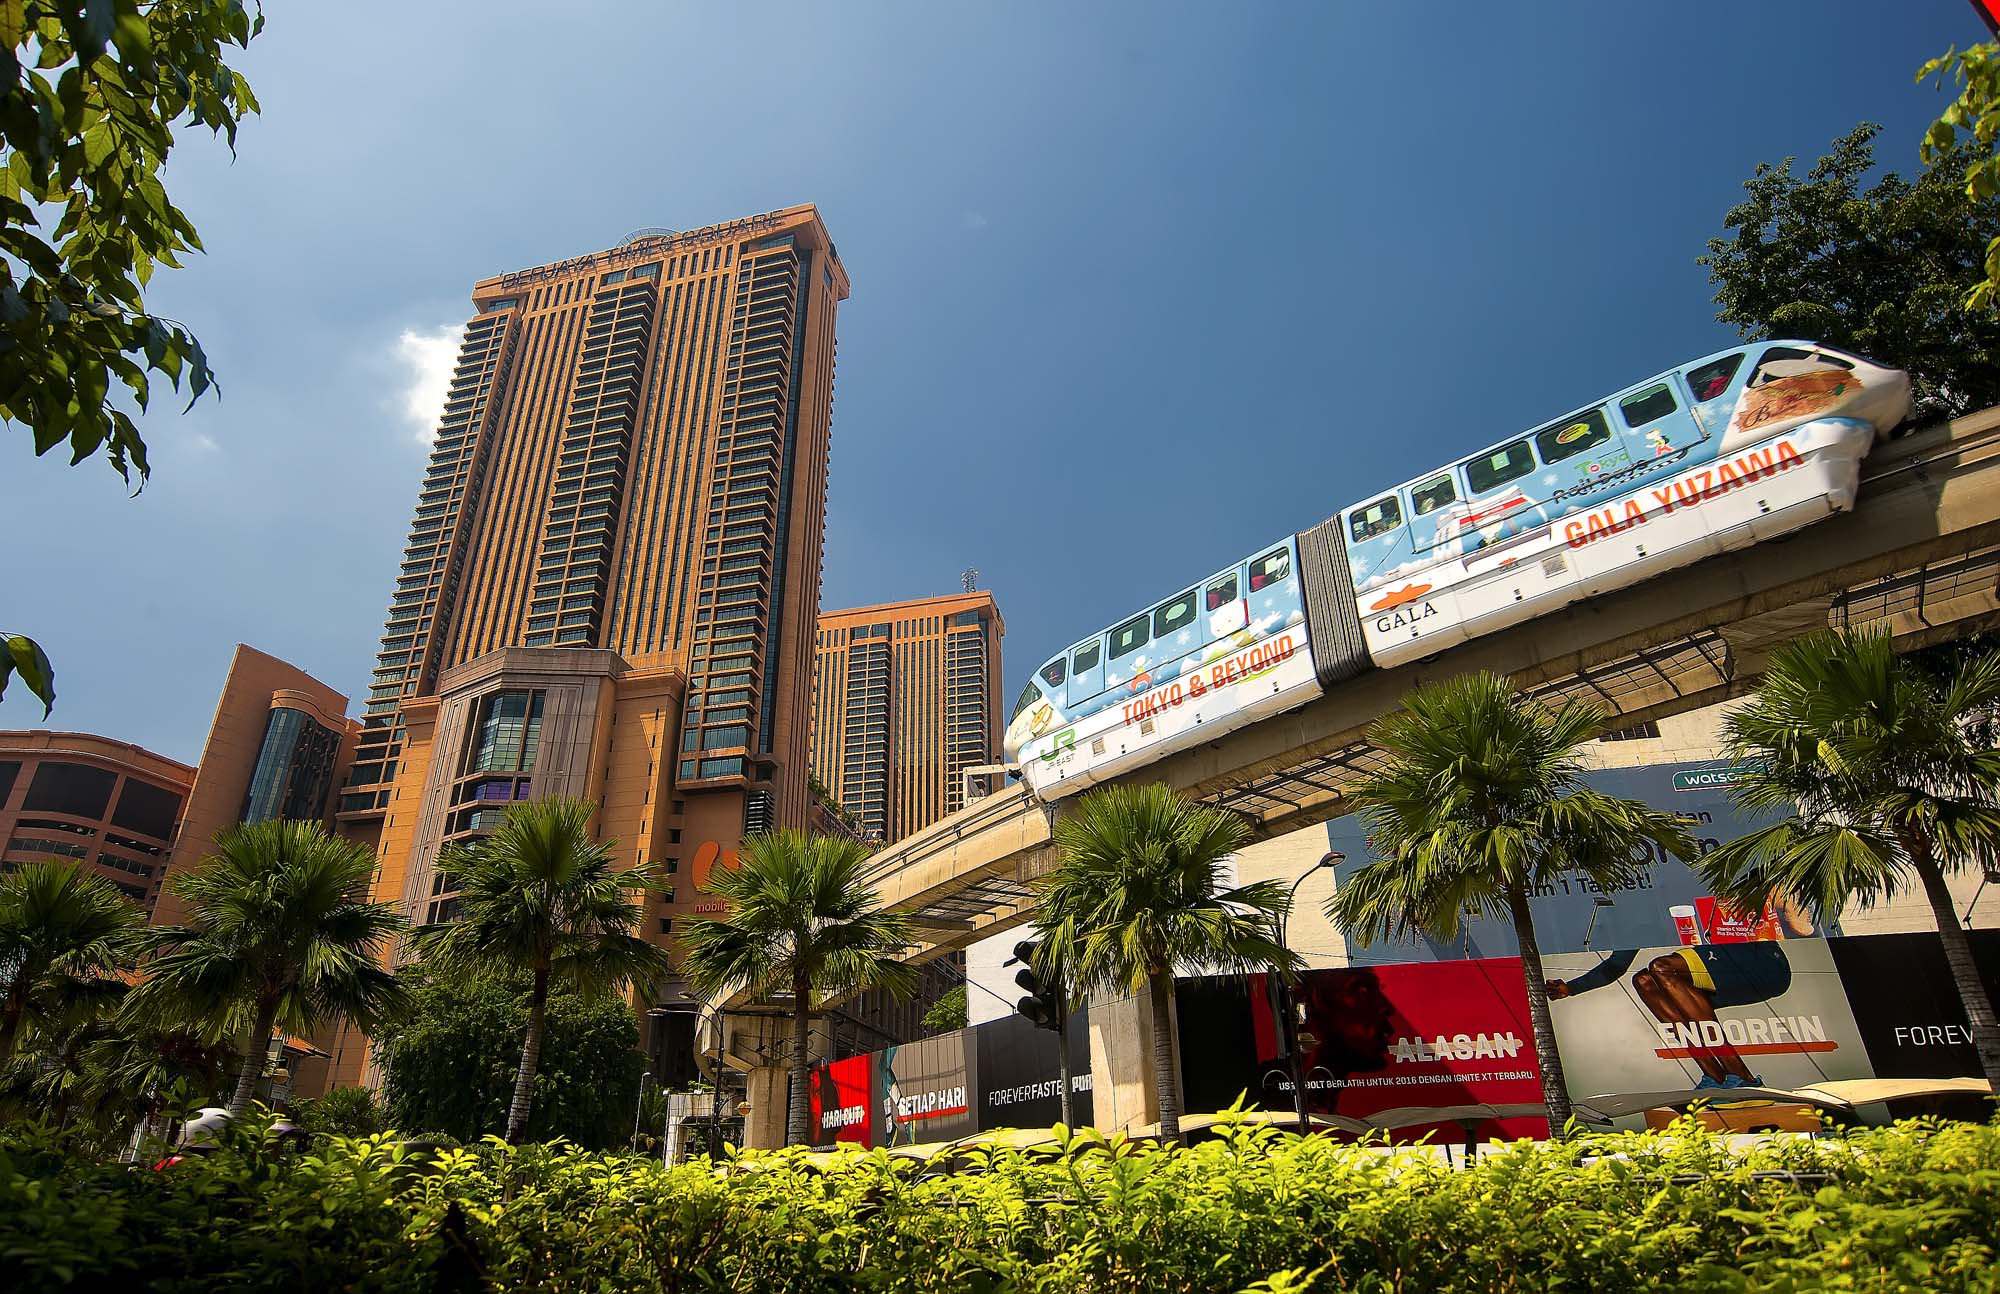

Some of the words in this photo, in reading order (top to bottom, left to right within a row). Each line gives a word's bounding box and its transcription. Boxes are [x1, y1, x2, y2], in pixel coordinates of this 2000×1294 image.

[501, 254, 598, 289] BERJAYA
[680, 209, 785, 247] SQUARE
[1575, 452, 1629, 477] Tokyo
[1564, 499, 1648, 548] GALA
[1652, 440, 1805, 516] YUZAWA
[1376, 601, 1439, 633] GALA
[1122, 683, 1184, 726] TOKYO
[1189, 674, 1208, 698] &
[1211, 635, 1295, 690] BEYOND
[1040, 728, 1077, 762] JR
[1395, 1031, 1519, 1064] ALASAN
[1656, 1015, 1827, 1048] ENDORFIN
[1326, 1077, 1365, 1089] BERLATIH
[1366, 1076, 1394, 1087] UNTUK
[1395, 1075, 1417, 1086] 2016
[1418, 1074, 1452, 1085] DENGAN
[1453, 1072, 1481, 1083] IGNITE
[1482, 1072, 1493, 1082] XT
[1494, 1070, 1536, 1081] TERBARU.
[898, 1091, 936, 1117] SETIAP
[938, 1085, 966, 1110] HARI
[823, 1109, 842, 1129] HARI
